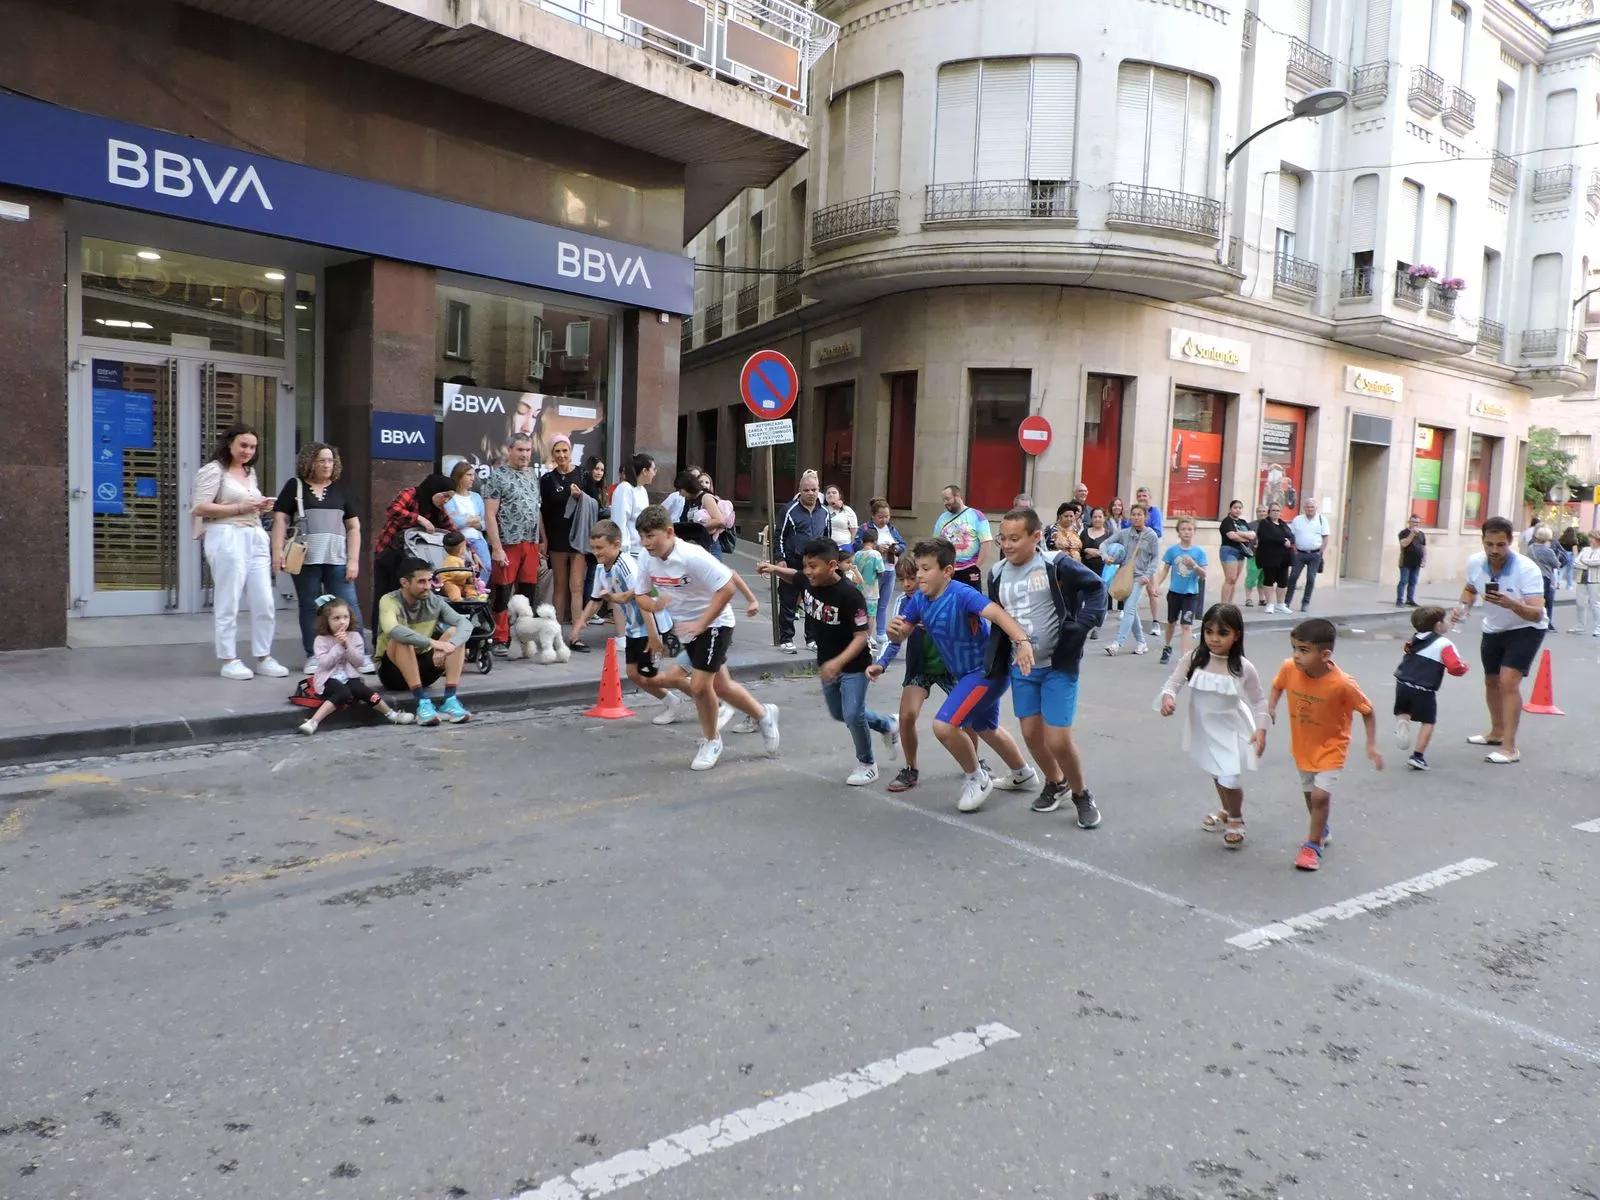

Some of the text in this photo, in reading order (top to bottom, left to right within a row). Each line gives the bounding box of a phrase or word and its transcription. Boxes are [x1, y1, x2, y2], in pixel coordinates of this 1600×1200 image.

[108, 138, 274, 211] BBVA
[557, 241, 653, 290] BBVA
[451, 394, 506, 414] BBVA
[380, 429, 426, 444] BBVA
